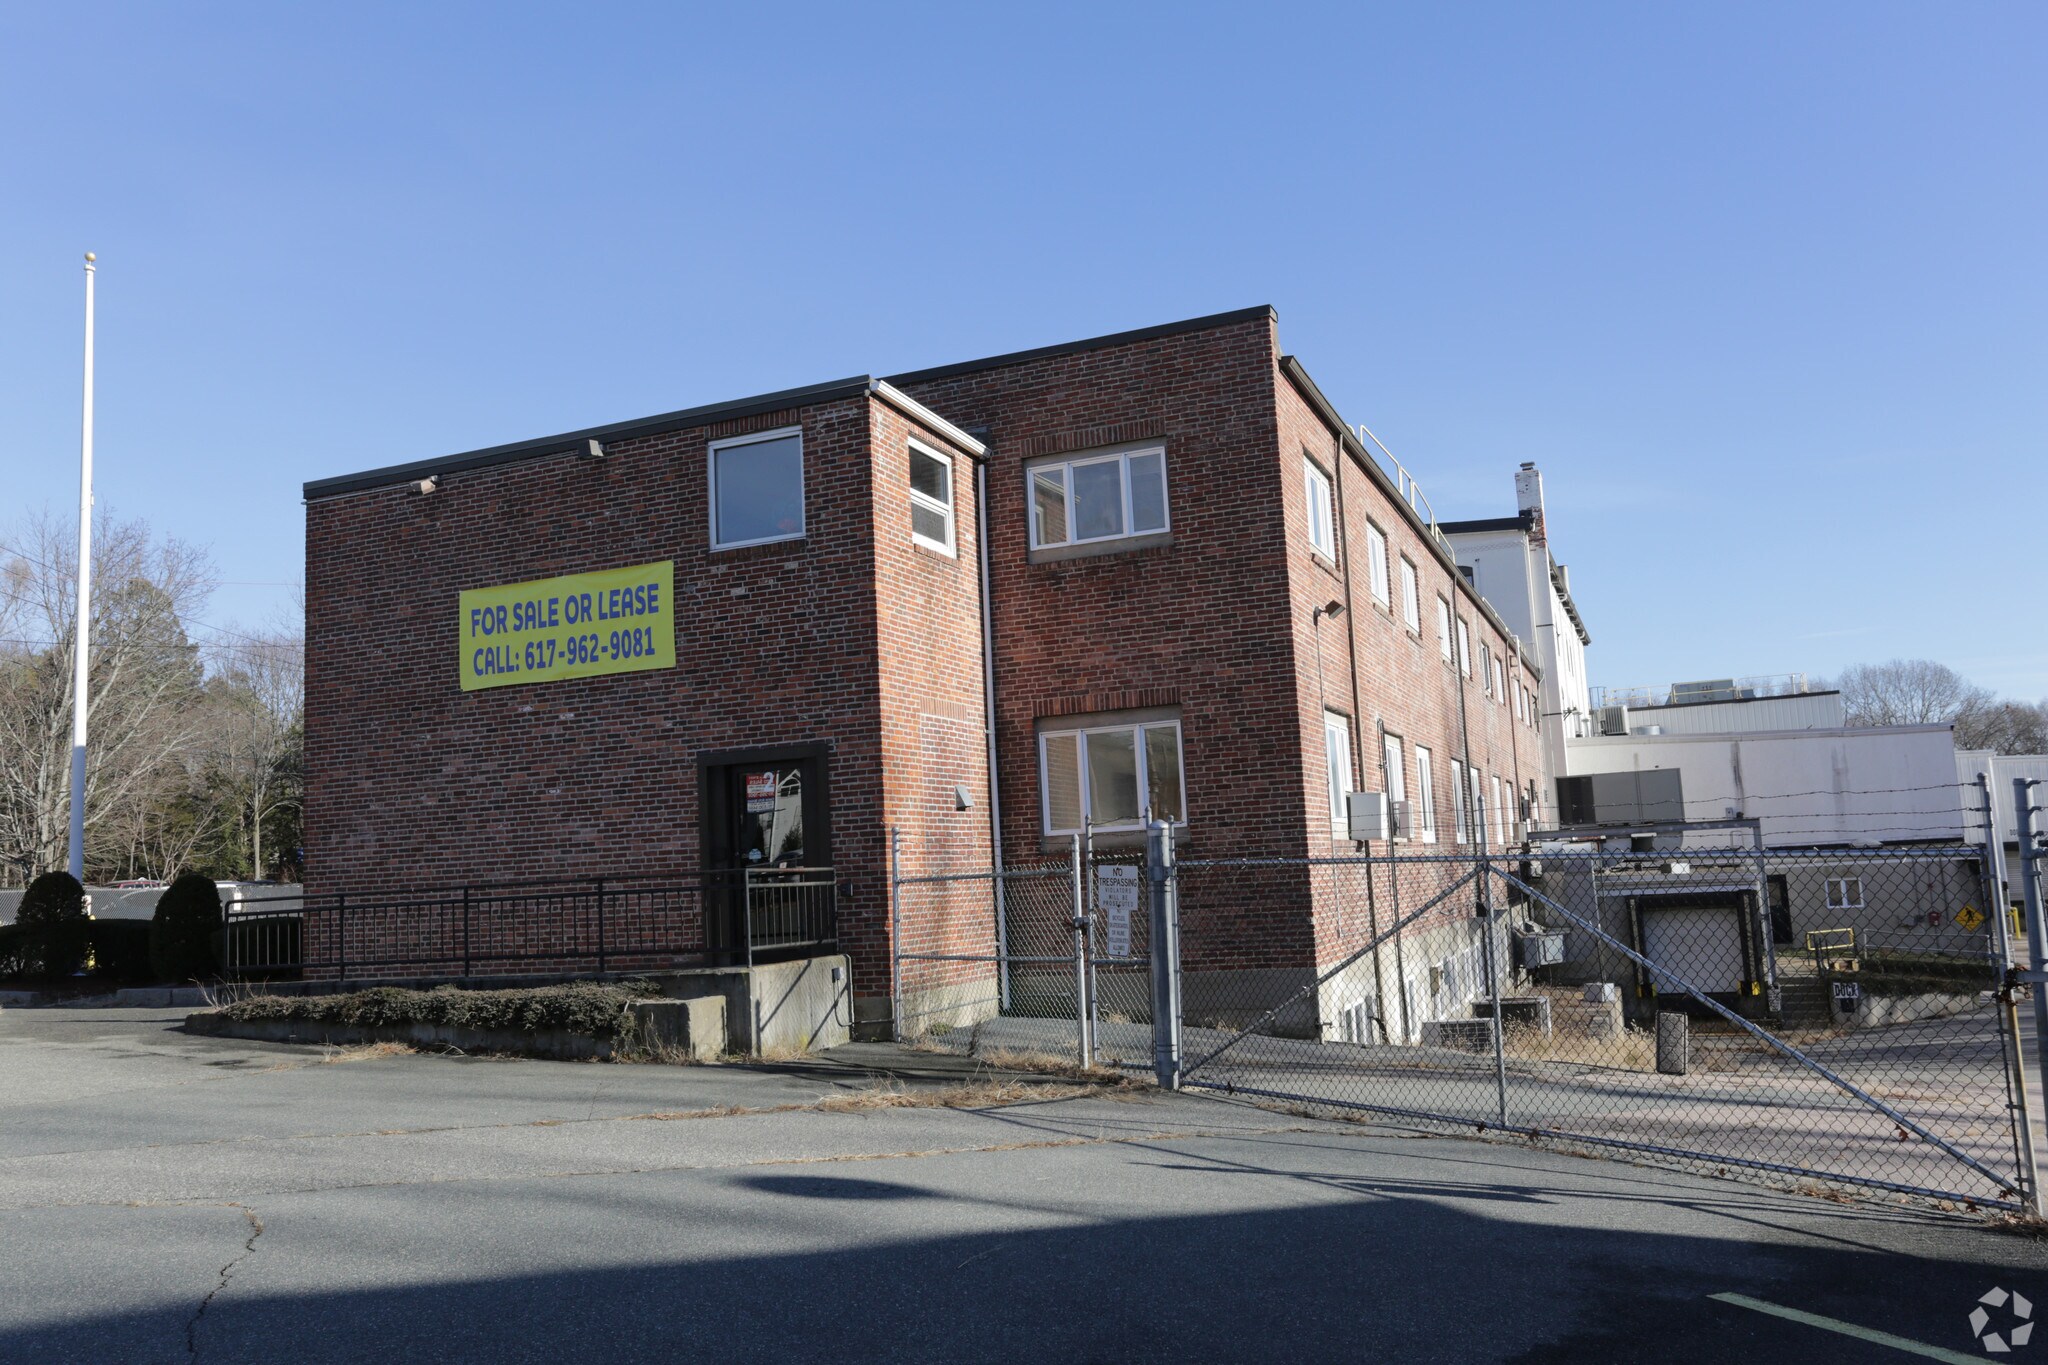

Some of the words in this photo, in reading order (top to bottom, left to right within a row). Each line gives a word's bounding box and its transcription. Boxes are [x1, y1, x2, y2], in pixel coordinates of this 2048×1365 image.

[471, 605, 508, 637] FOR
[513, 597, 559, 632] SALE
[565, 593, 592, 624] OR
[598, 583, 659, 620] LEASE
[473, 645, 520, 676] CALL:
[525, 626, 655, 670] 617-962-9081
[1099, 877, 1137, 887] TRESPASSING
[1113, 868, 1123, 876] NO
